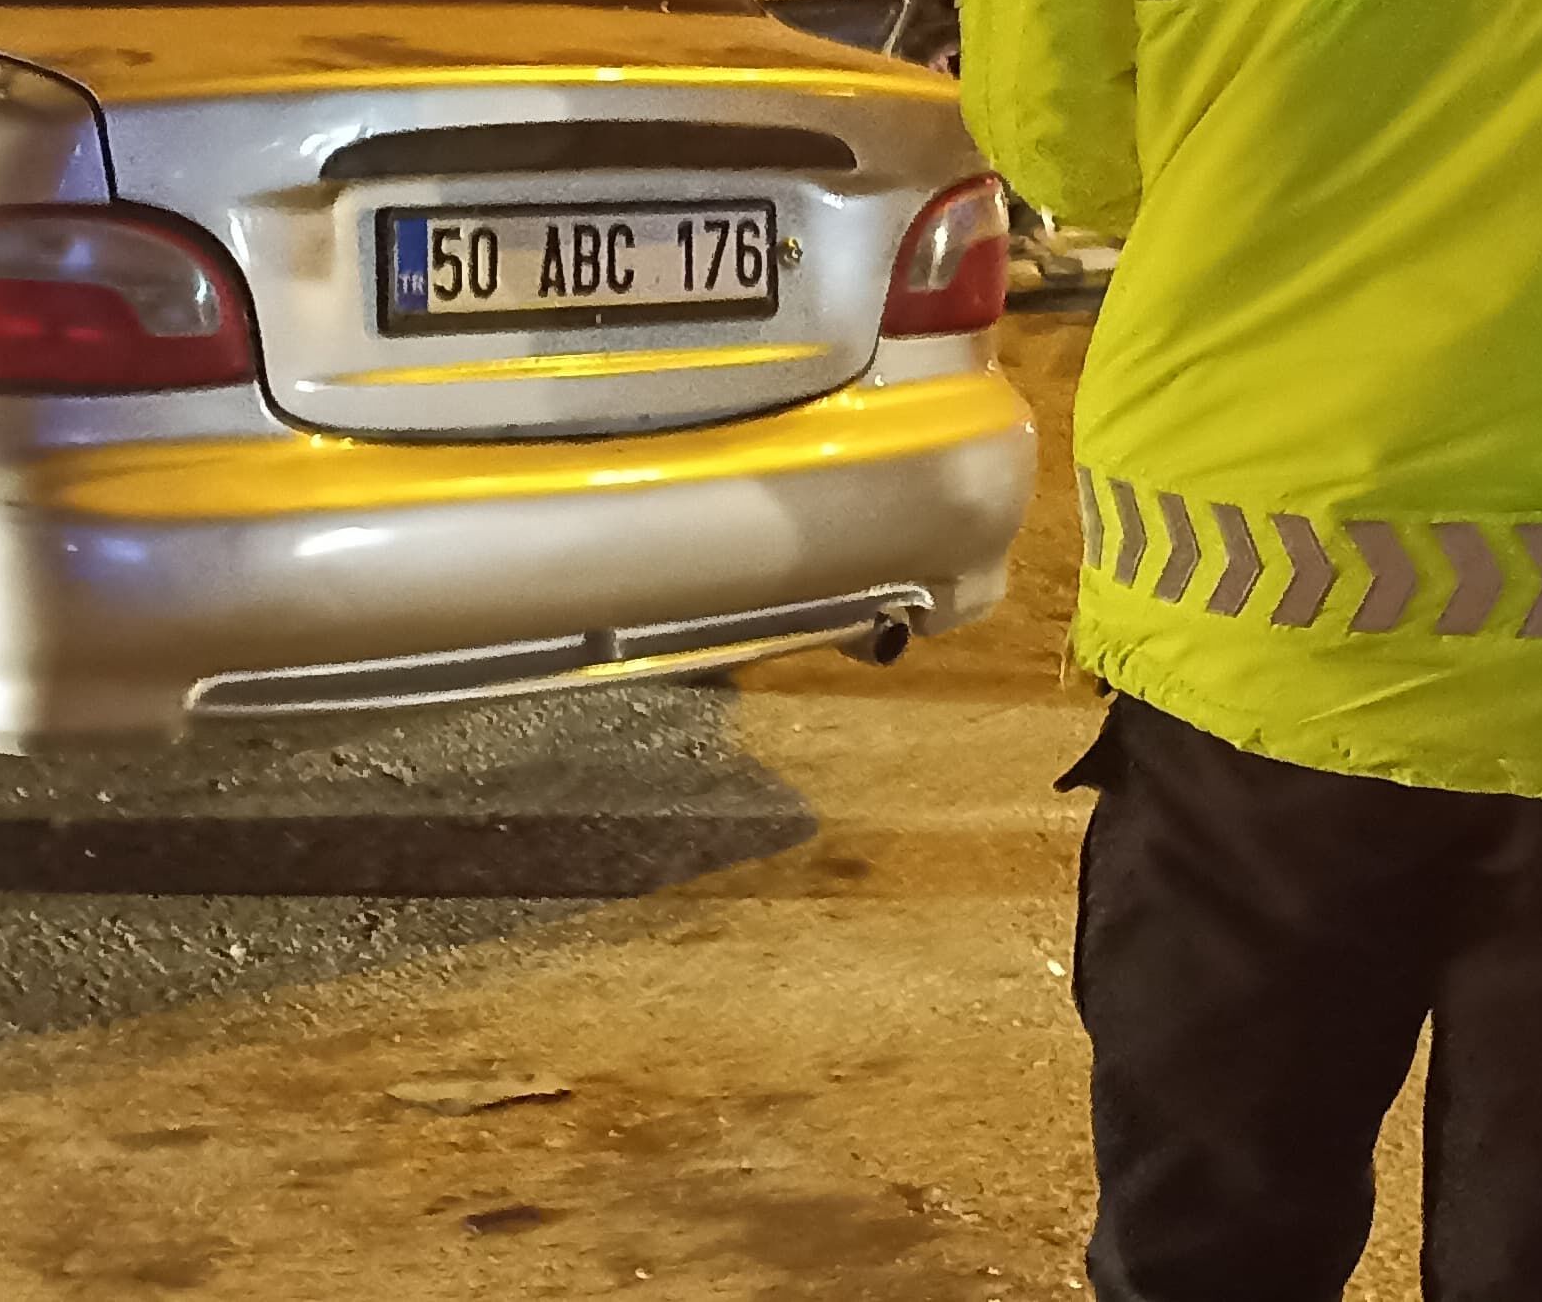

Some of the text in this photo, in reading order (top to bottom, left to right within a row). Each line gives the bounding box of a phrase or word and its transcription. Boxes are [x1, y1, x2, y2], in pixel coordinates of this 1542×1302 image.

[397, 272, 426, 295] TR
[431, 218, 763, 301] 50 ABC 176
